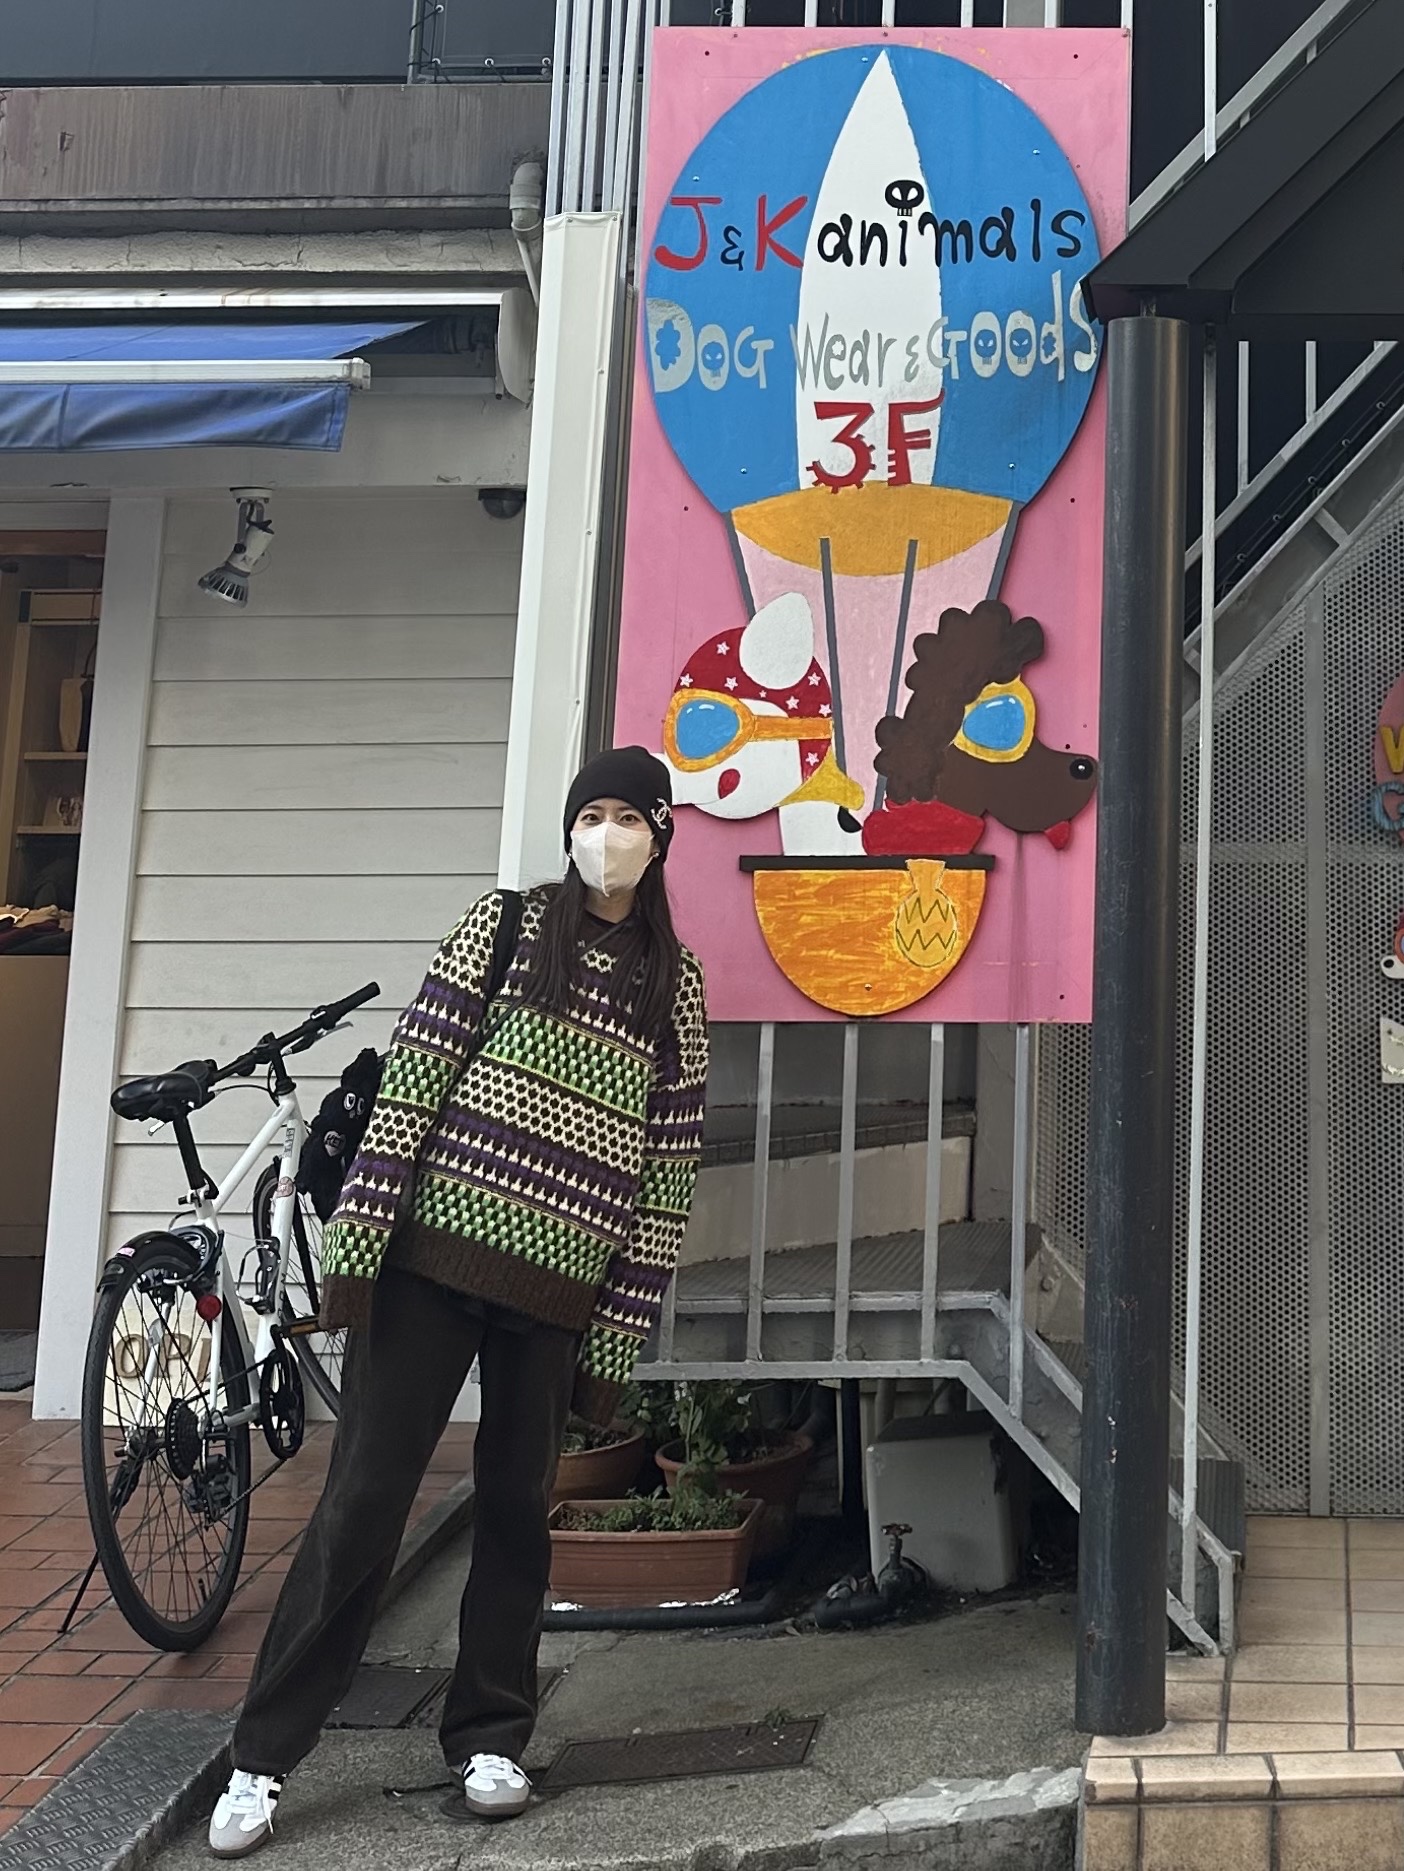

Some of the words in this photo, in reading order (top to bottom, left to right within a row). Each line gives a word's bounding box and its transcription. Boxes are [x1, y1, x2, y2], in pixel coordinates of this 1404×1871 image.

[817, 181, 1086, 267] animals
[790, 312, 897, 391] Wear
[806, 387, 945, 494] 3F
